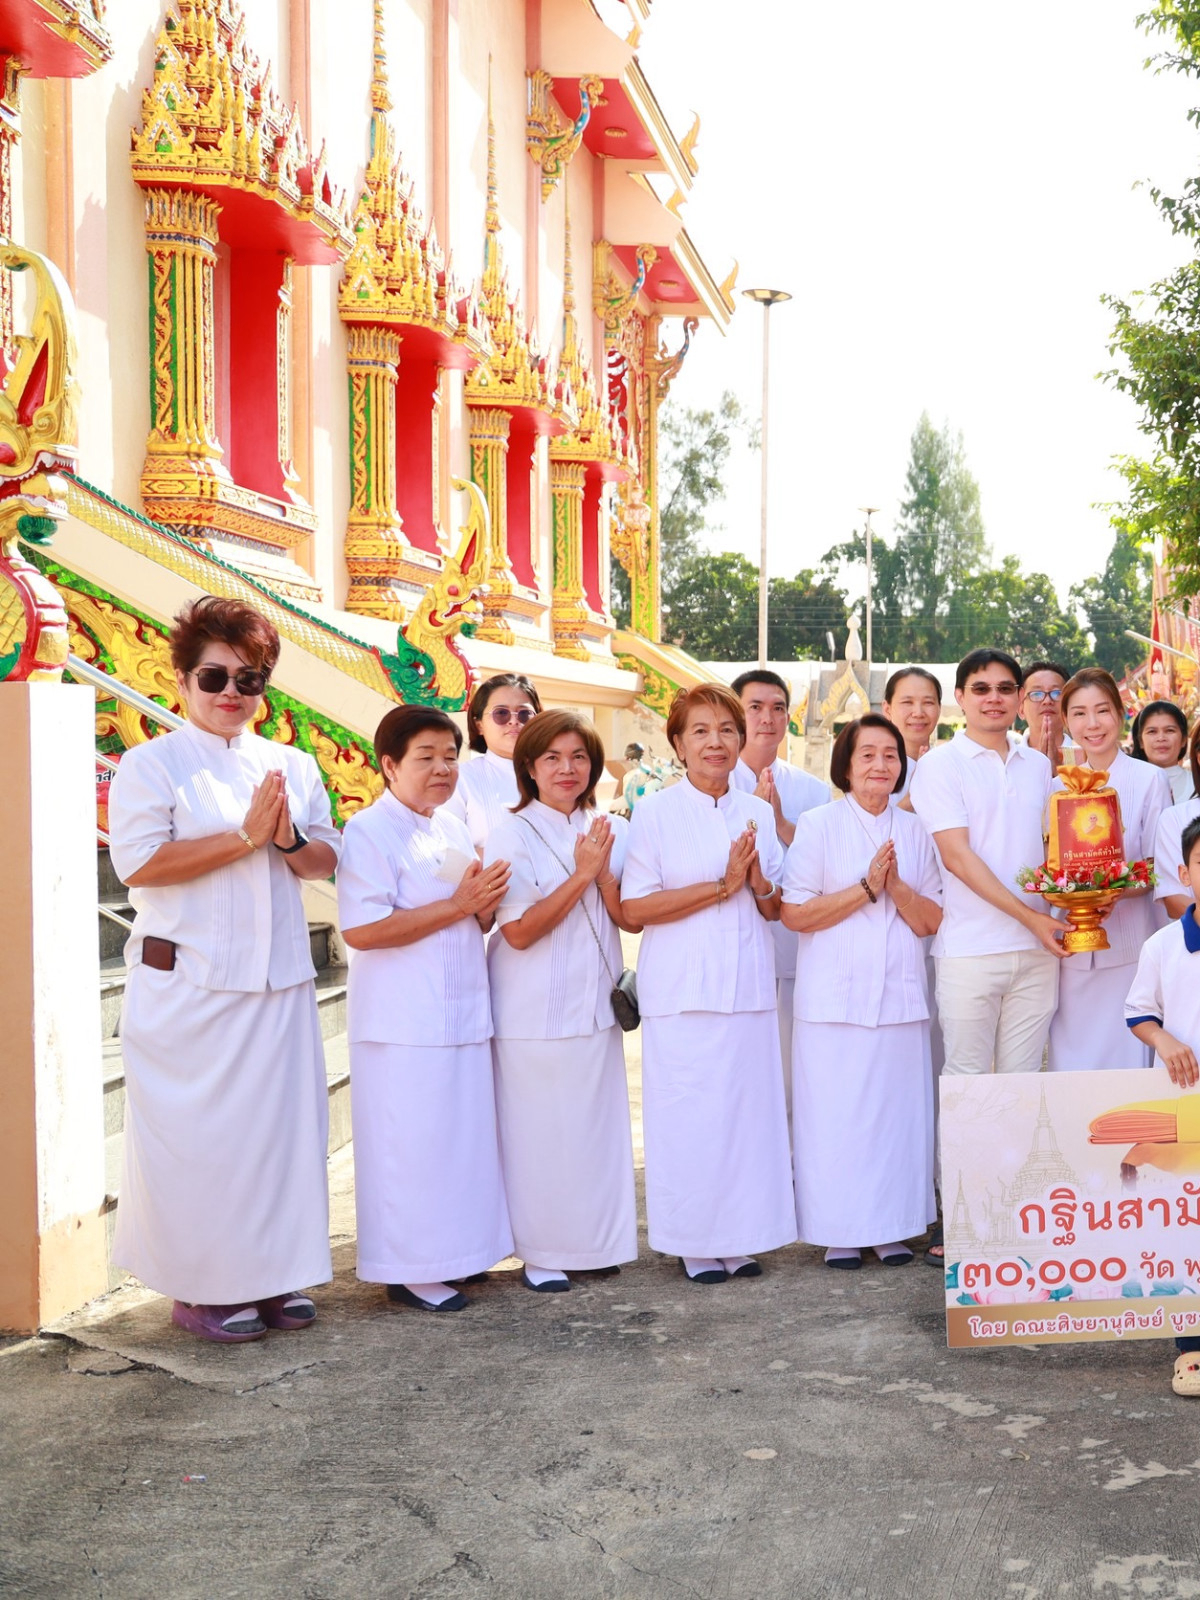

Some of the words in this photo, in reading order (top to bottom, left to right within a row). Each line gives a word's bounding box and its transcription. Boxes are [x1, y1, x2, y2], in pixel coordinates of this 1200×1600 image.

[963, 1256, 1128, 1292] ๓๐,๐๐๐
[1139, 1251, 1175, 1280] วัด
[970, 1318, 1006, 1336] โดย
[1014, 1308, 1163, 1335] คณะศิษยานุศิษย์
